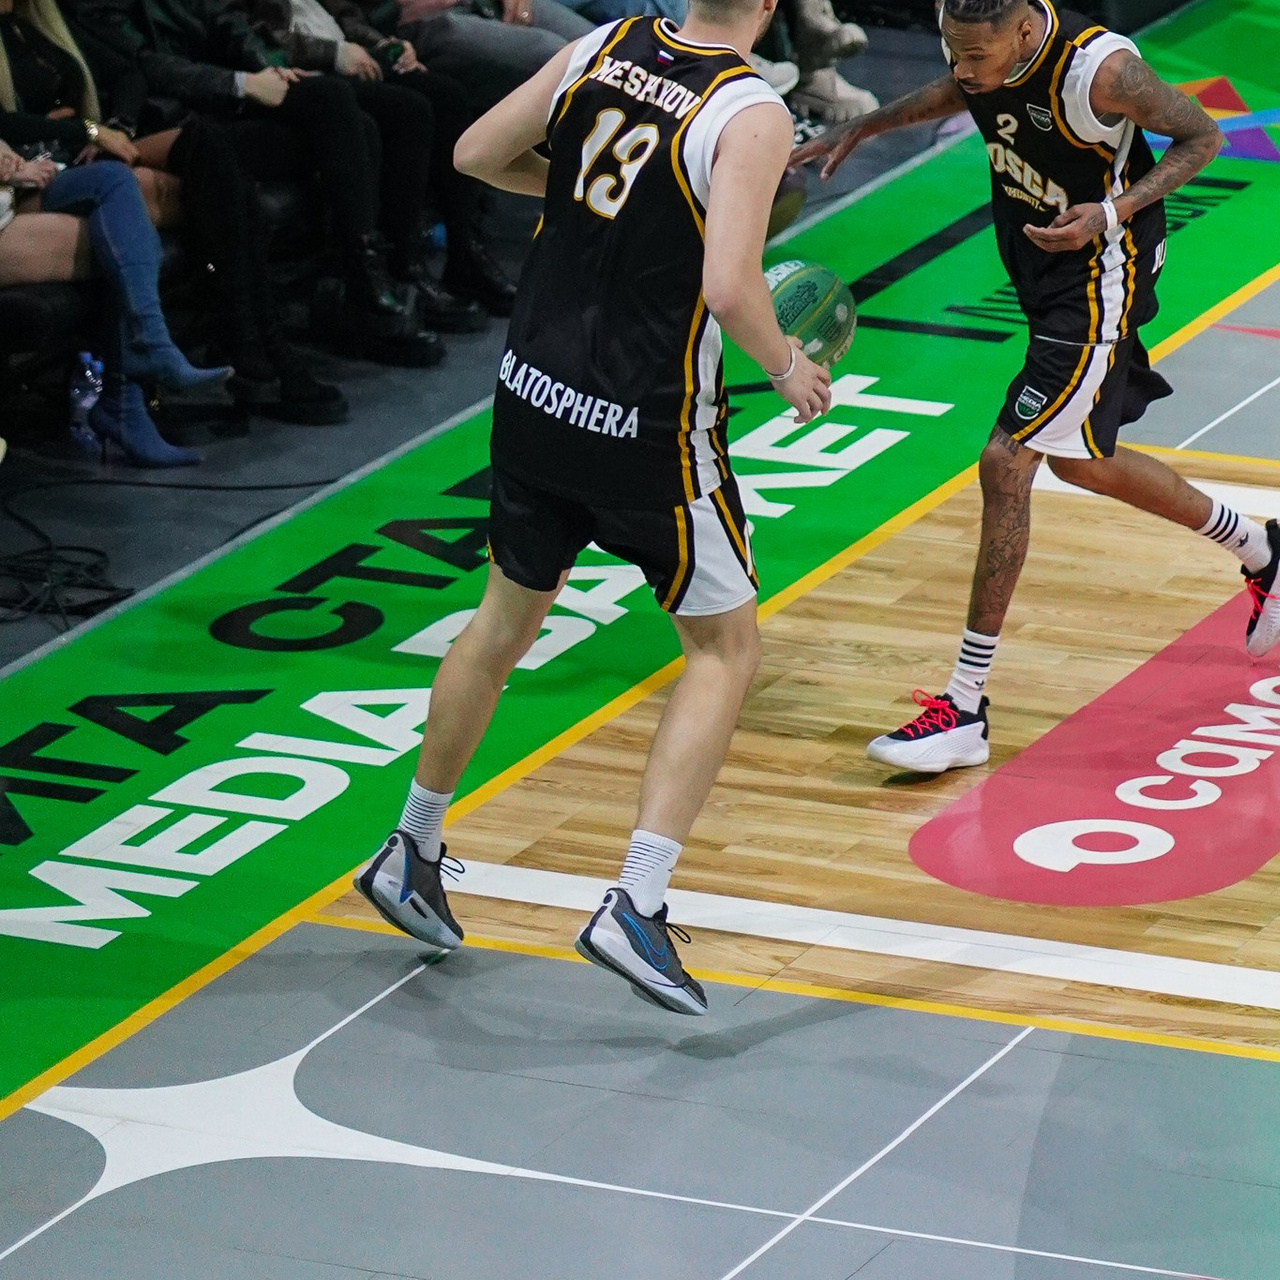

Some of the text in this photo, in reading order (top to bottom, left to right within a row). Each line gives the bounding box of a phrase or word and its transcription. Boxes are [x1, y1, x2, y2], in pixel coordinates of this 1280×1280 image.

[573, 107, 660, 220] 13
[996, 113, 1019, 146] 2
[499, 349, 639, 438] BLATOSPHERA
[390, 373, 955, 671] BAKET
